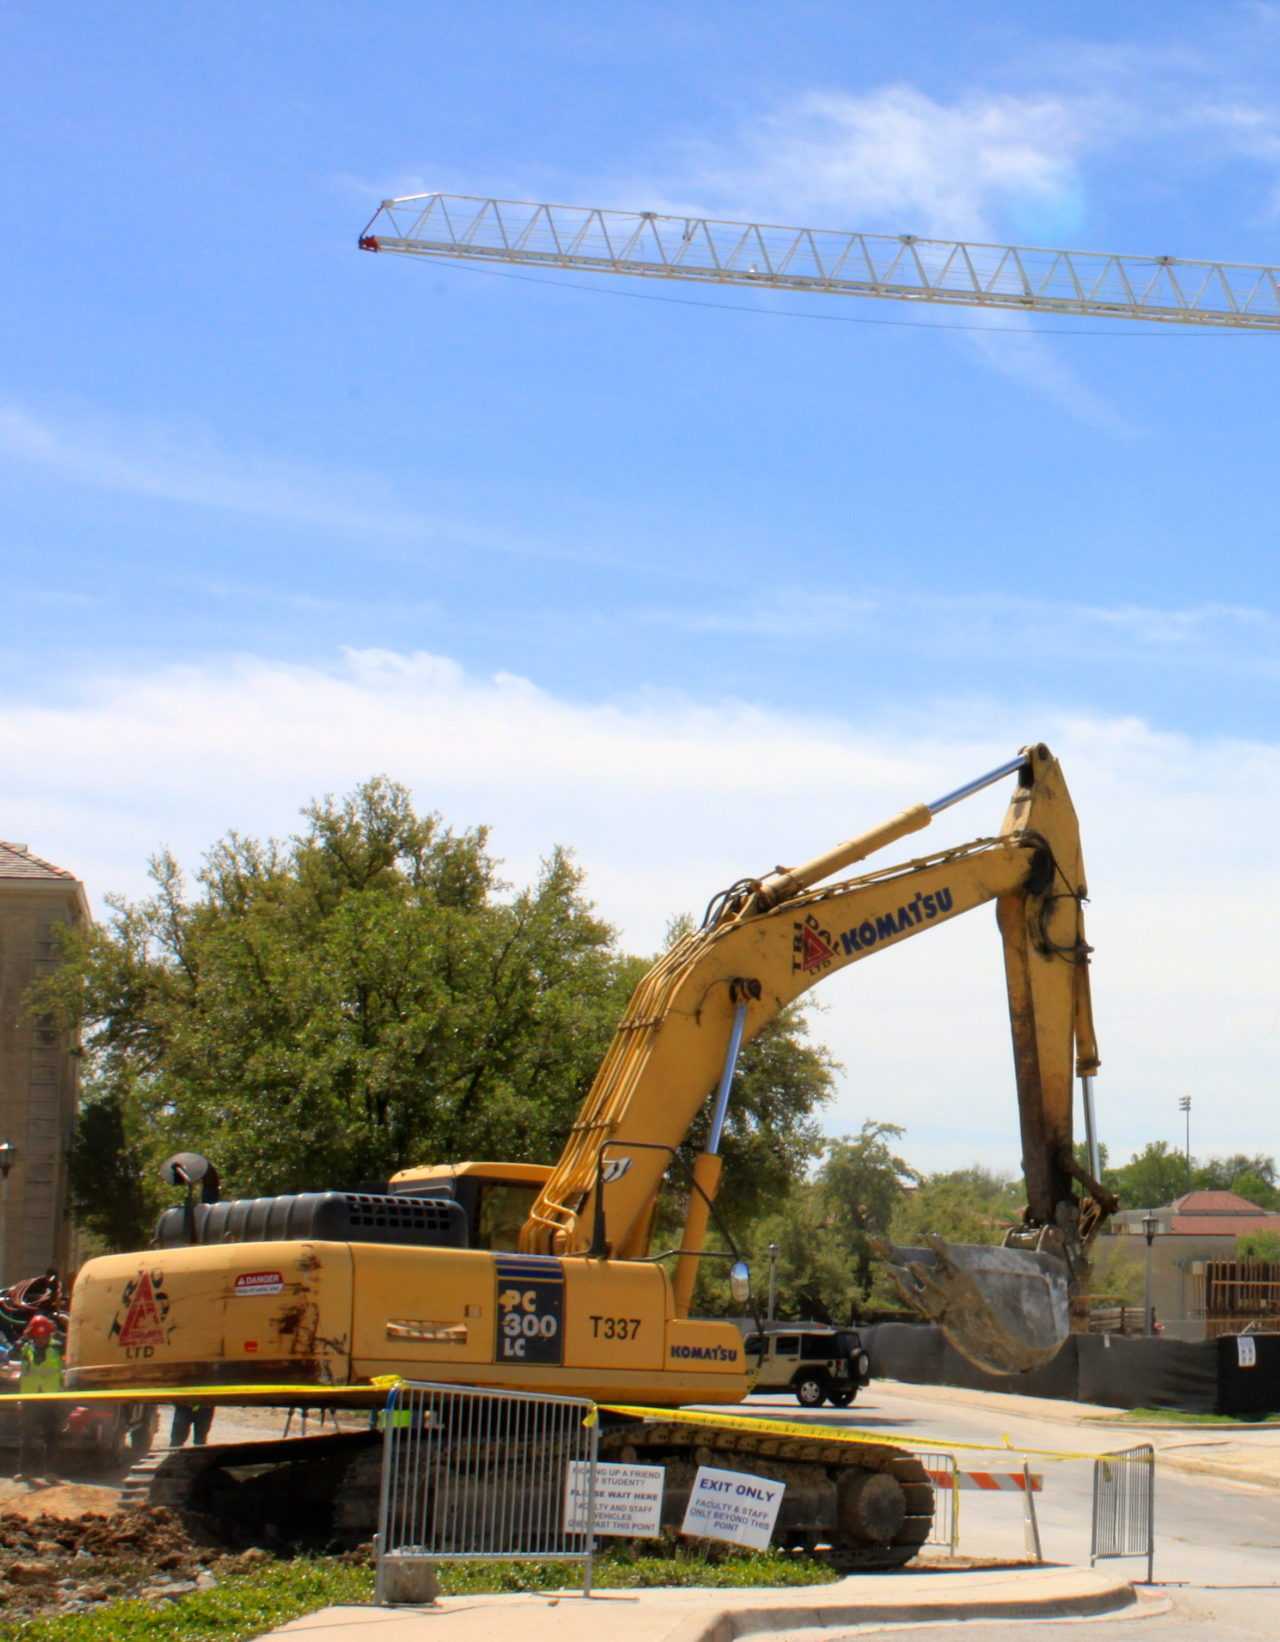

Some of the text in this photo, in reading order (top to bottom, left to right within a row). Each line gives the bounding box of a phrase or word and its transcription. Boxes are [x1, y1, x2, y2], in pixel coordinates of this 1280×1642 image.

[840, 887, 953, 956] KOMATSU
[502, 1290, 537, 1312] PC
[503, 1314, 558, 1338] 300
[589, 1315, 642, 1340] T337
[125, 1345, 155, 1360] LTD
[504, 1338, 527, 1358] LC
[671, 1344, 737, 1362] KOMATSU
[609, 1469, 621, 1477] UP
[630, 1470, 661, 1480] FRIEND
[607, 1491, 632, 1499] WAIT
[634, 1492, 659, 1501] HERE
[700, 1478, 775, 1502] EXIT ONLY
[629, 1505, 653, 1513] STAFF
[695, 1498, 733, 1512] FACULTY
[742, 1506, 769, 1519] STAFF
[713, 1511, 749, 1524] BEYOND
[713, 1521, 739, 1532] POINT
